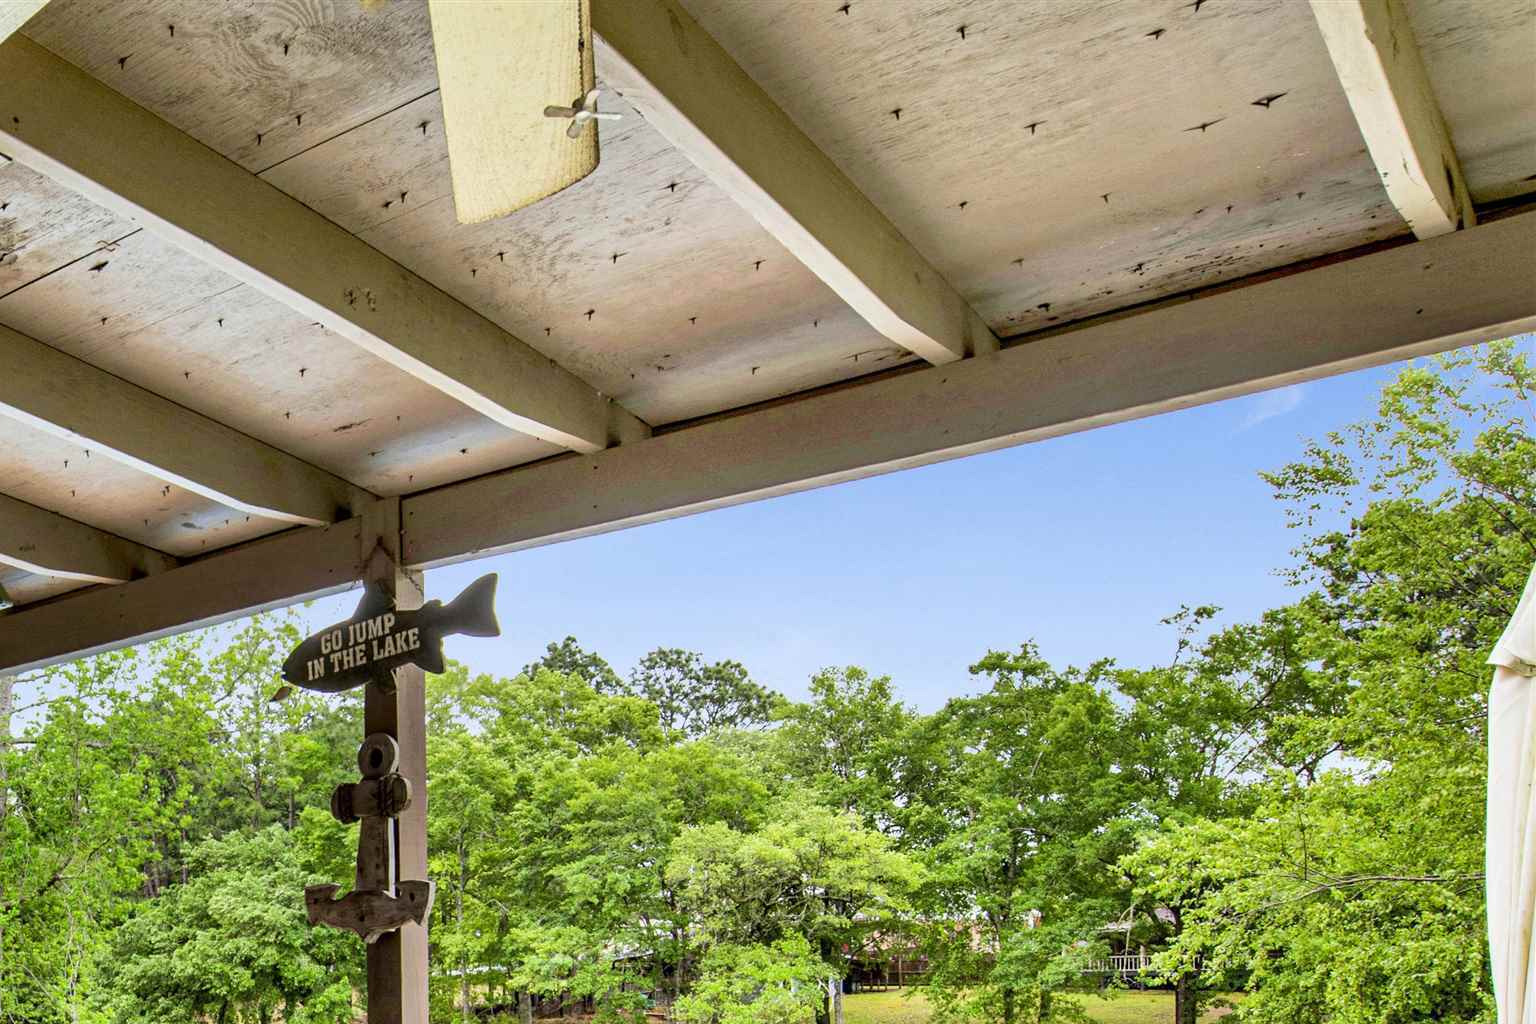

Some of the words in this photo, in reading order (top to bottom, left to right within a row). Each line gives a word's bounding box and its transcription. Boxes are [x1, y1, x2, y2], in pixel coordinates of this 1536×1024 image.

[306, 656, 325, 681] IN
[329, 643, 367, 673] THE
[372, 627, 421, 661] LAKE
[320, 629, 343, 655] GO
[348, 612, 396, 646] JUMP
